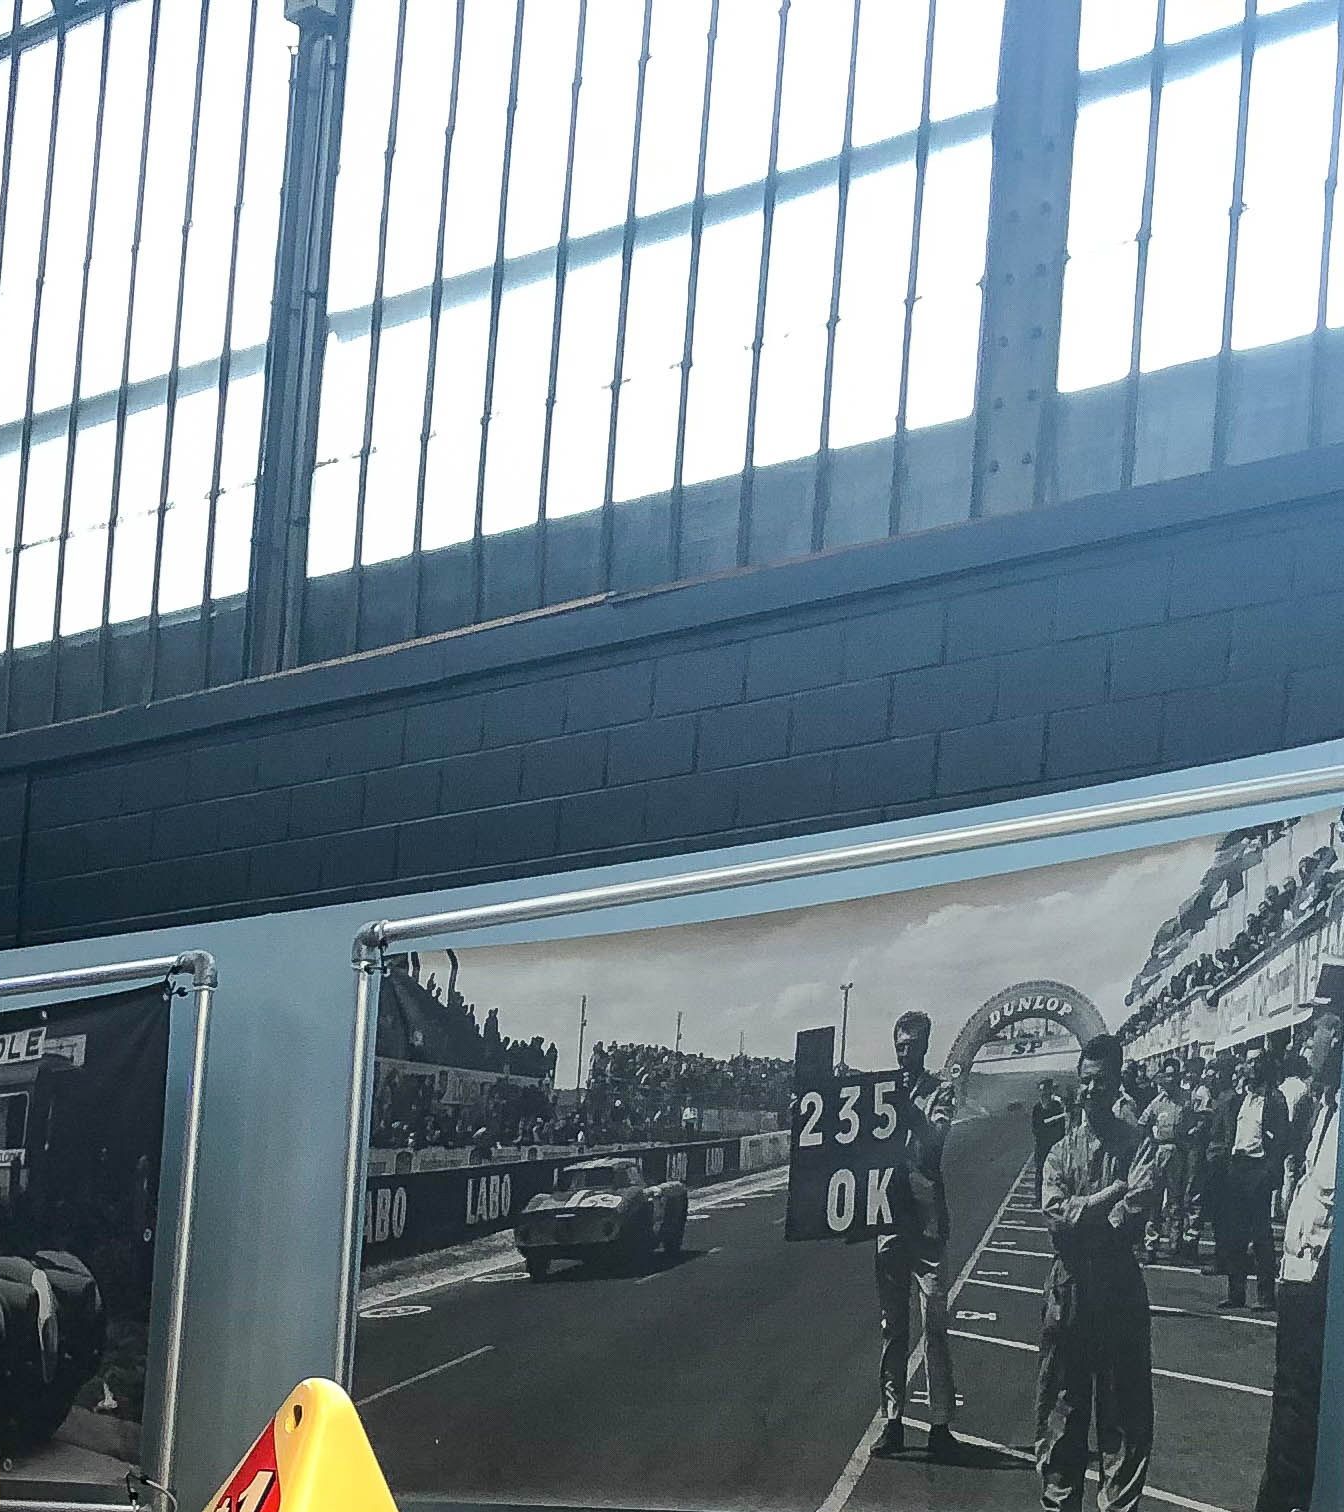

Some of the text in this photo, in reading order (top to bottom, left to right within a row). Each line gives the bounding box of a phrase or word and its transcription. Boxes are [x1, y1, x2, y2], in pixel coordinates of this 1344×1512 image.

[989, 995, 1073, 1028] DUNLOP
[799, 1081, 897, 1147] 235
[365, 1186, 407, 1244] ABO
[466, 1173, 512, 1225] LABO
[827, 1168, 894, 1232] OK
